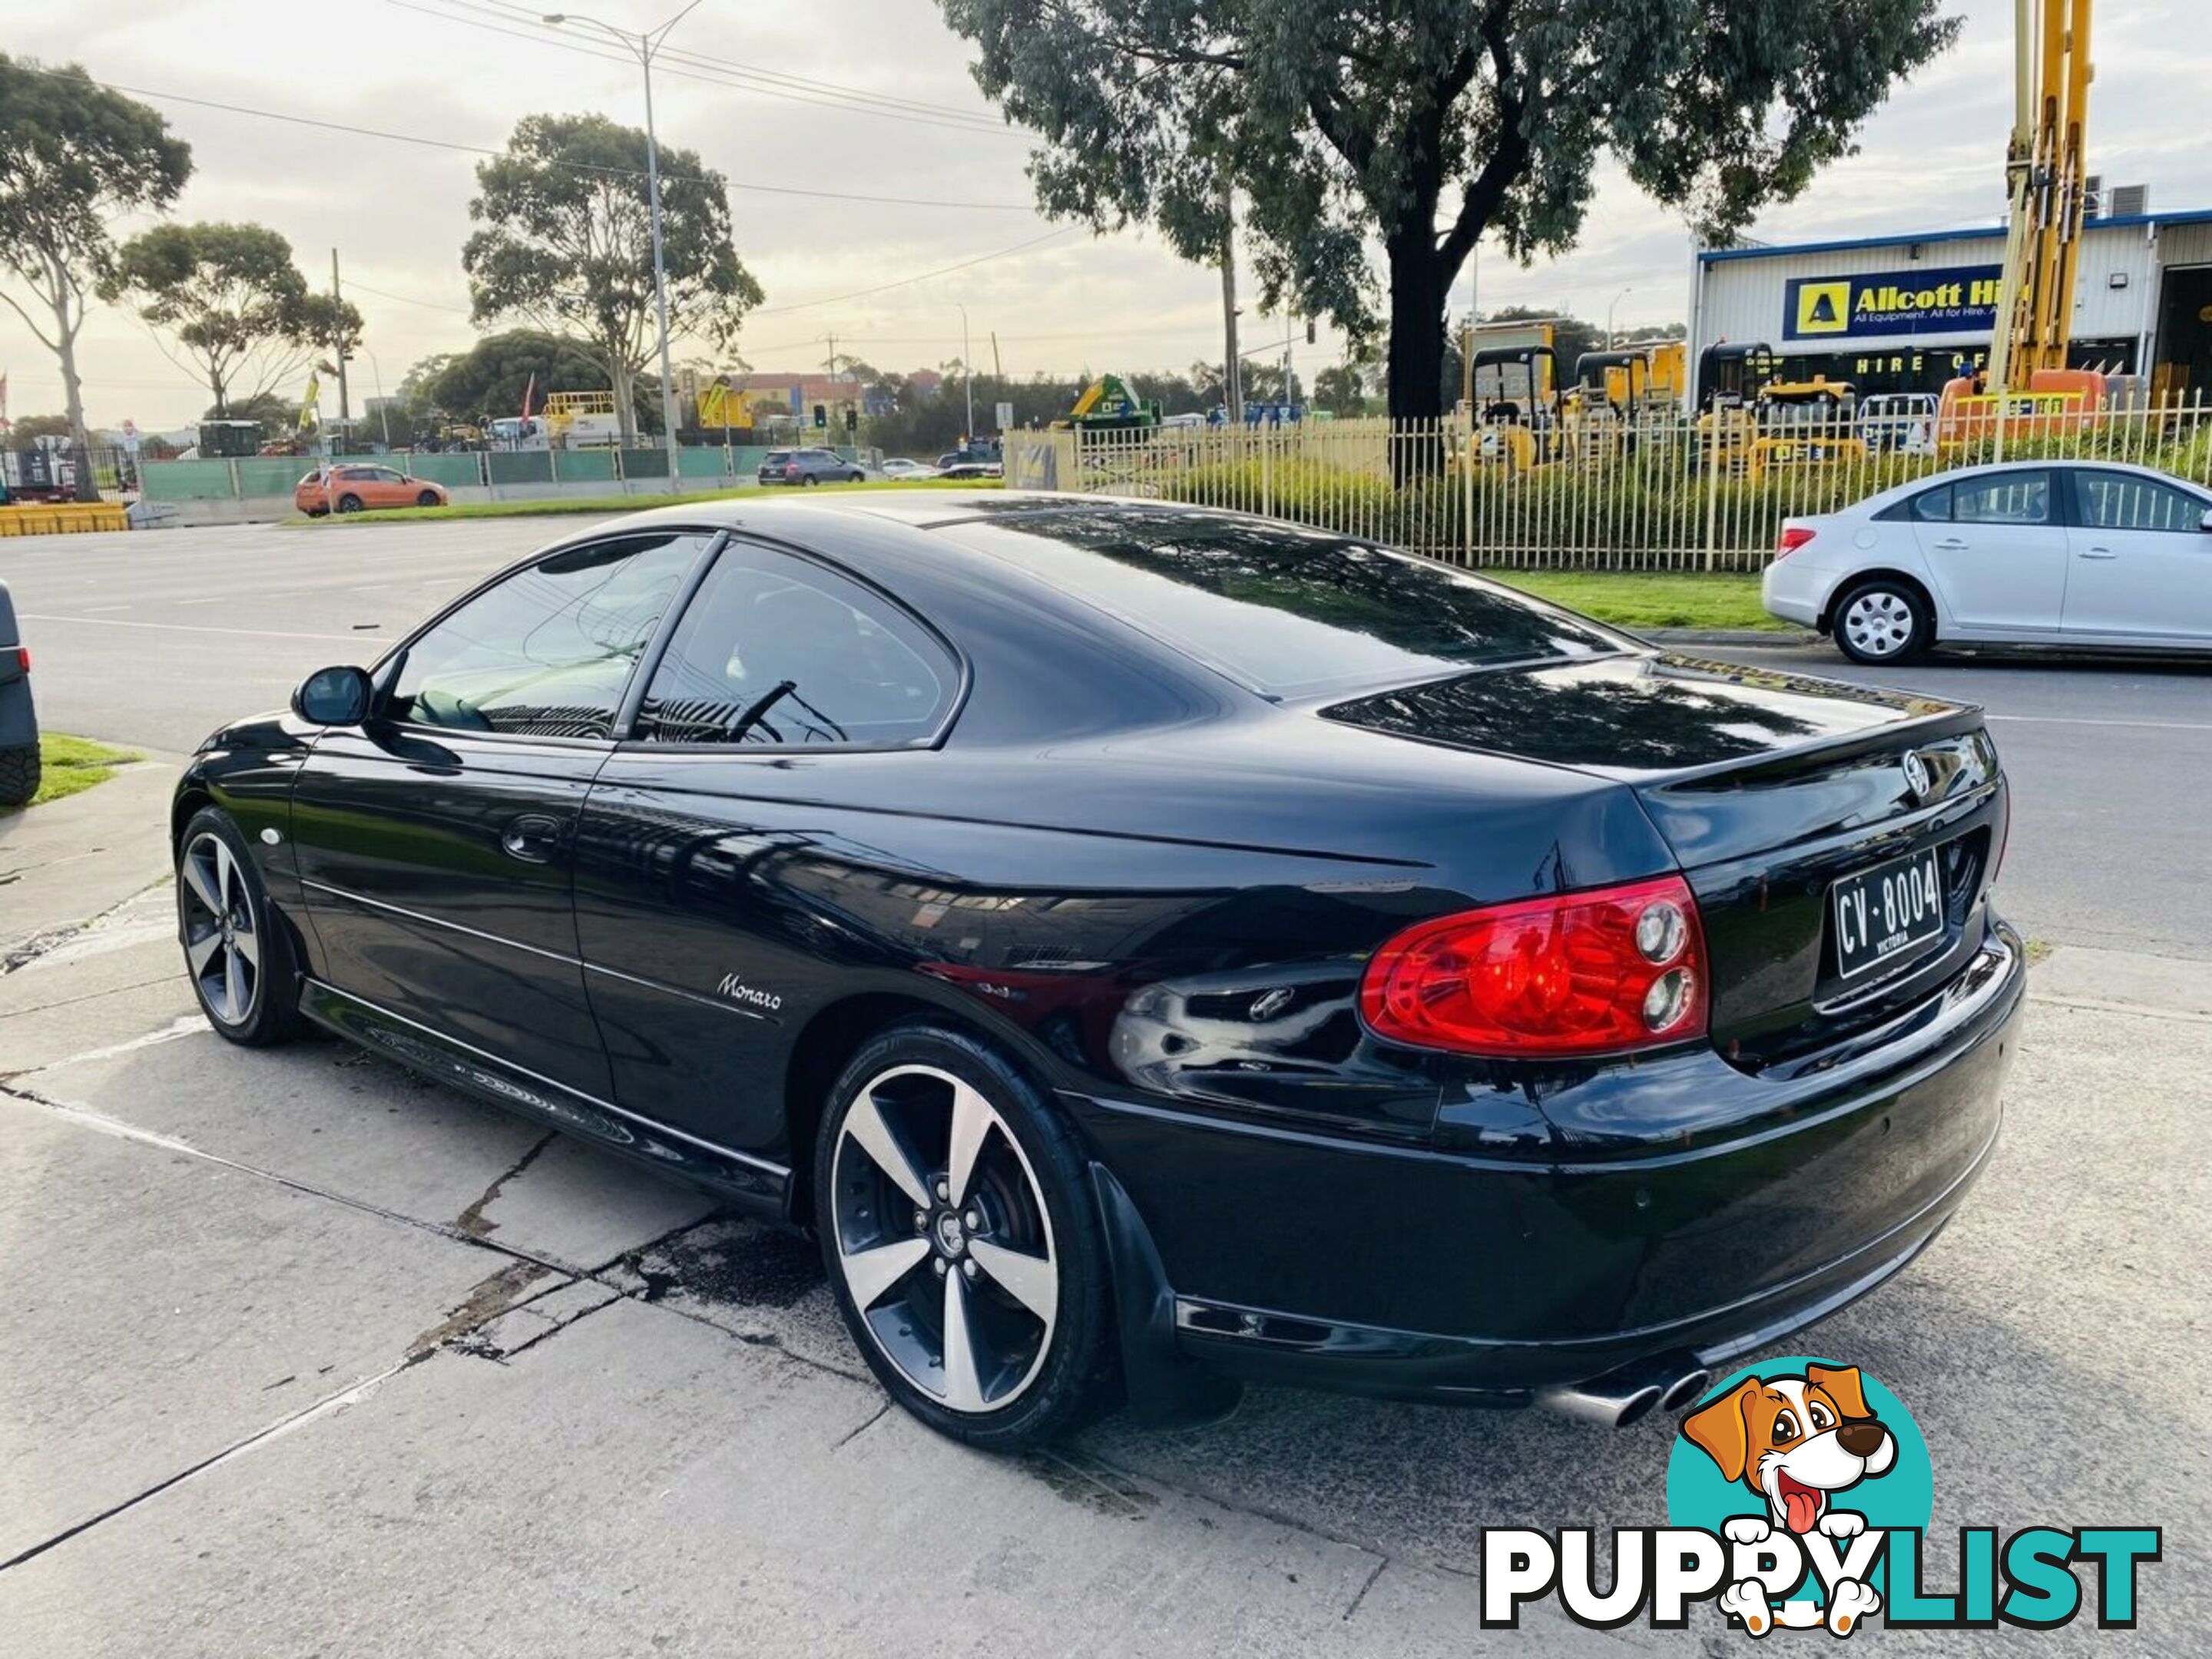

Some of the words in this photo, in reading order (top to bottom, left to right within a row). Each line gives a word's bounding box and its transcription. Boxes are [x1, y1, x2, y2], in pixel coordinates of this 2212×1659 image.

[1856, 282, 1962, 313] Allcott
[1853, 313, 1867, 323] All
[1869, 310, 1928, 323] Equipment.
[1929, 309, 1943, 319] All
[1945, 308, 1961, 317] for
[1962, 307, 1986, 316] Hire.
[1856, 356, 1922, 375] HIRE
[1876, 930, 1909, 955] VICTORIA
[717, 972, 782, 1010] Monaro
